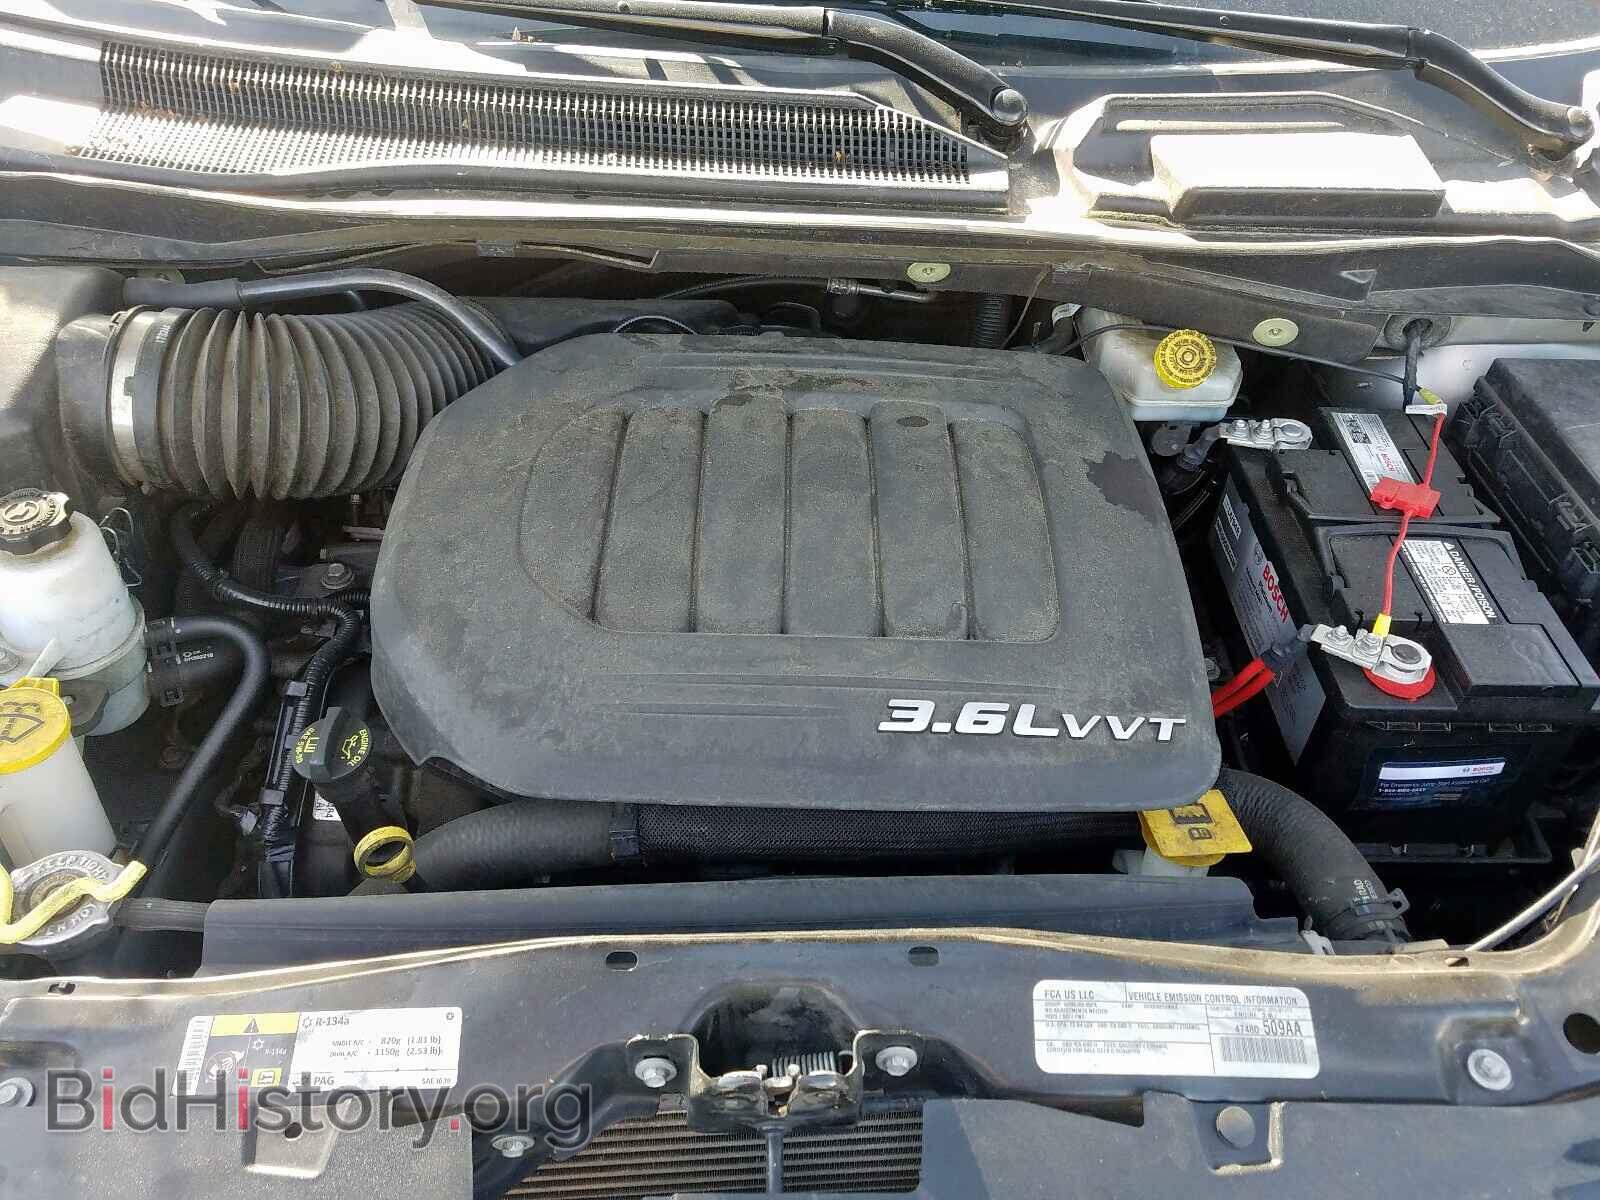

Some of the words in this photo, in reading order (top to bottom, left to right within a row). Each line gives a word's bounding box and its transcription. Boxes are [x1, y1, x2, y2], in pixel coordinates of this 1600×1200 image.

[1381, 453, 1395, 472] BOSCH
[1262, 563, 1290, 624] BOSCH
[877, 699, 1060, 738] 3.6L
[1061, 713, 1187, 742] VVT
[359, 728, 369, 755] ENGINE
[347, 755, 362, 767] OIL
[1044, 989, 1062, 1000] FCA
[1064, 990, 1076, 1000] US
[1078, 990, 1095, 1000] LLC
[1128, 991, 1161, 1002] VEHICLE
[1164, 992, 1202, 1003] EMISSION
[1204, 993, 1239, 1004] CONTROL
[1243, 995, 1298, 1006] INFORMATION
[315, 1016, 350, 1027] R-134a
[1262, 1019, 1303, 1037] 509AA
[430, 1035, 442, 1045] lb)
[375, 1047, 400, 1057] 1150g
[406, 1047, 428, 1057] (2.53
[430, 1046, 441, 1056] lb)
[314, 1076, 335, 1086] PAG
